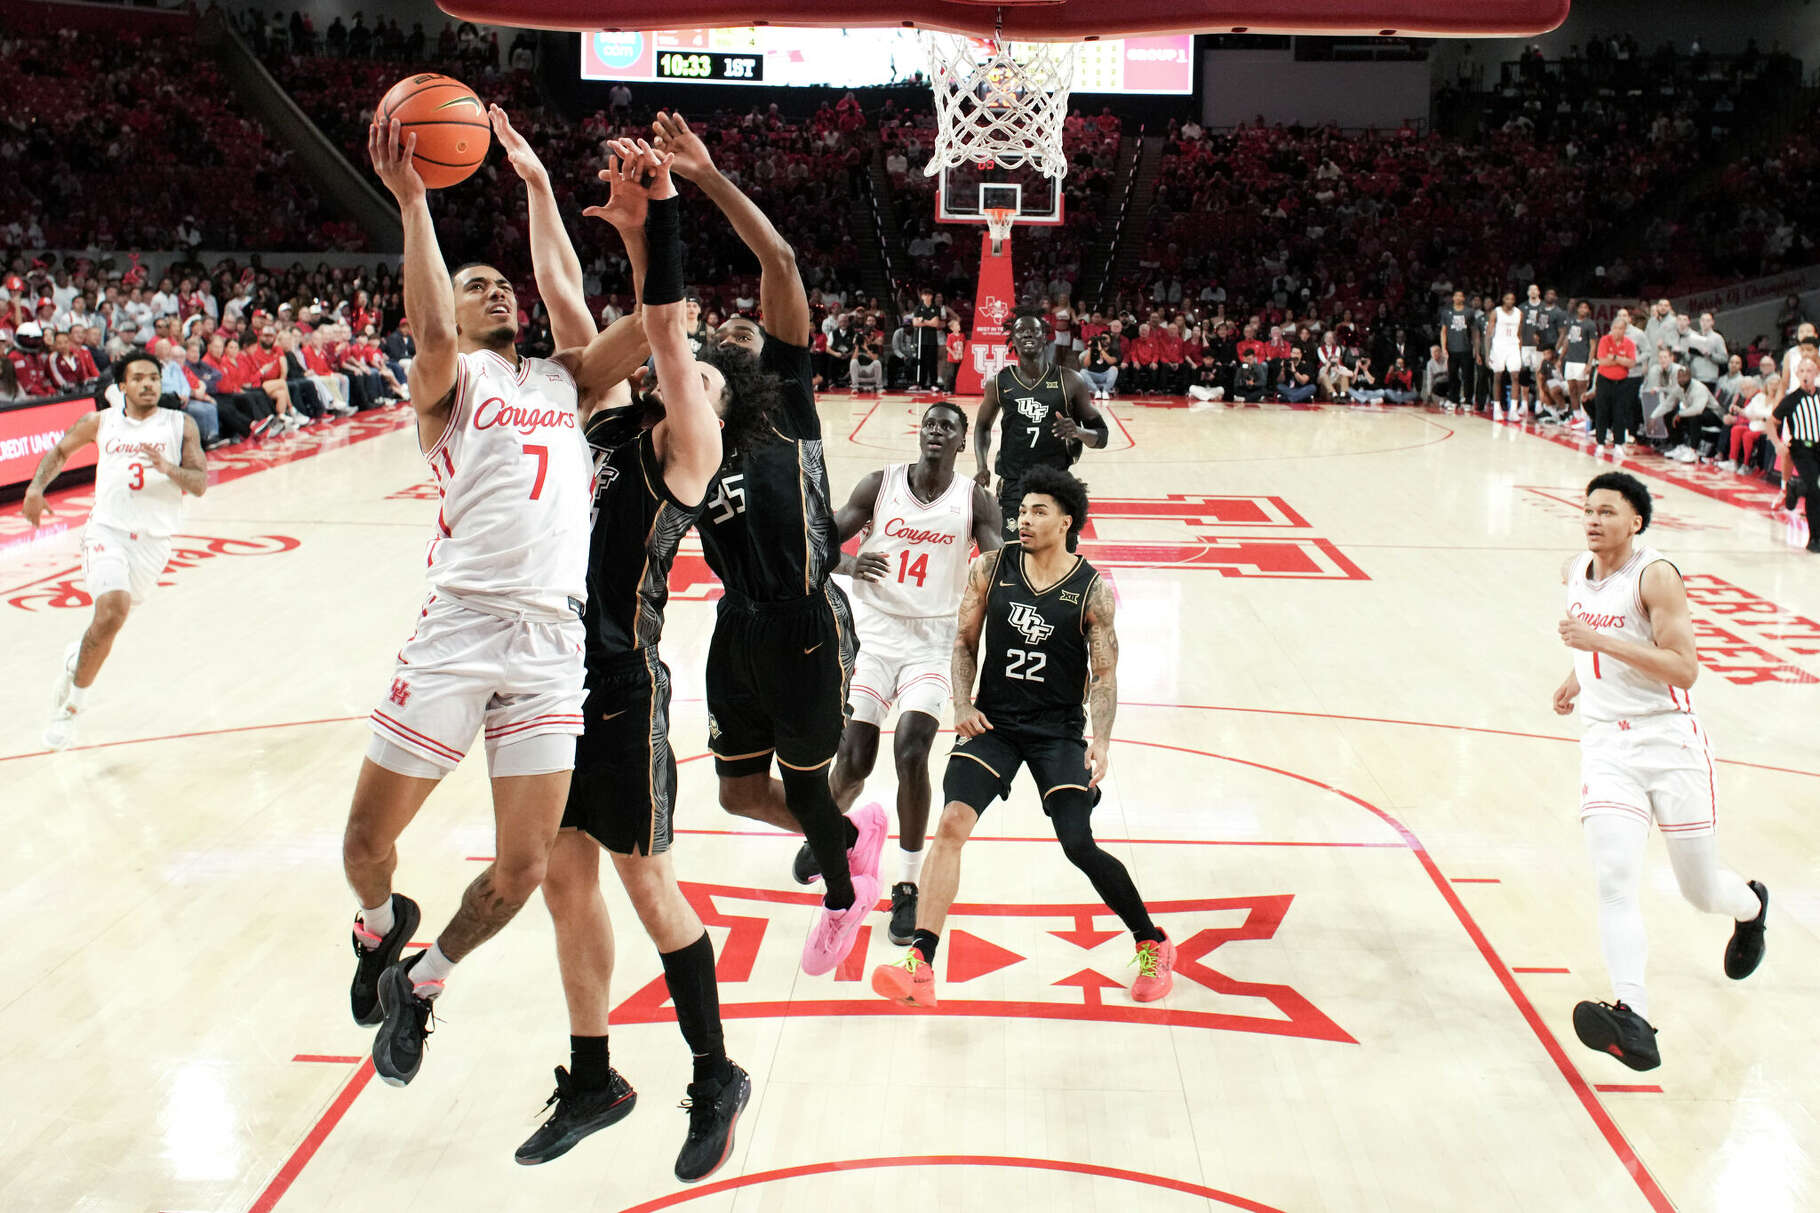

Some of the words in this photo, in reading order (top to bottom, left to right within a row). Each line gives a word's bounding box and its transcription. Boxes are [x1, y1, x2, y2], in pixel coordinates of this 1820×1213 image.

[660, 53, 712, 77] 10:33
[724, 58, 756, 78] 1ST
[473, 397, 575, 435] Cougars
[1014, 397, 1049, 423] UCF
[1026, 427, 1040, 448] 7
[128, 462, 144, 491] 3
[522, 444, 549, 500] 7
[884, 517, 956, 545] Cougars
[898, 549, 929, 587] 14
[1007, 601, 1055, 645] UCF
[1005, 648, 1047, 682] 22
